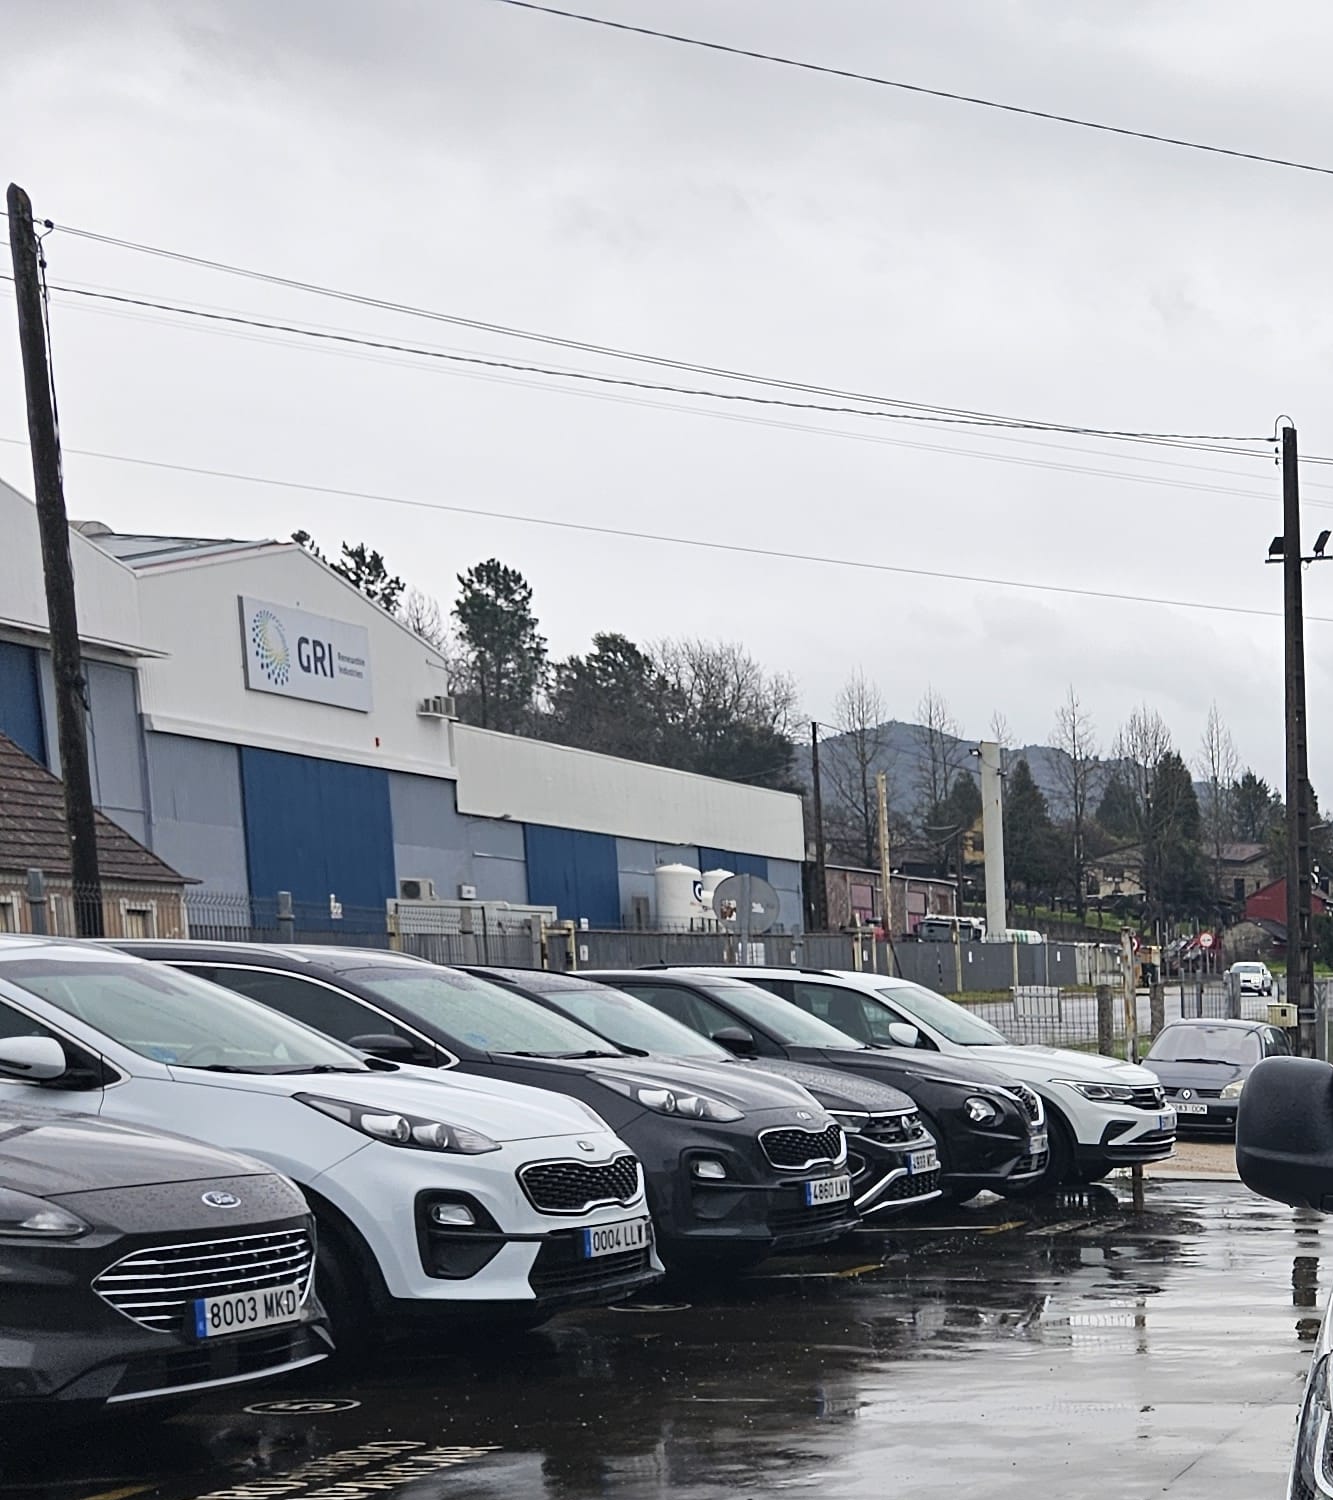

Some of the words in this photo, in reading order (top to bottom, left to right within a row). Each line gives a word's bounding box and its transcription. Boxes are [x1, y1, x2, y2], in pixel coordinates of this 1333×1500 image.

[297, 636, 334, 678] GRI
[593, 1227, 621, 1251] 0004
[211, 1296, 258, 1328] 8003
[264, 1290, 296, 1319] MKD
